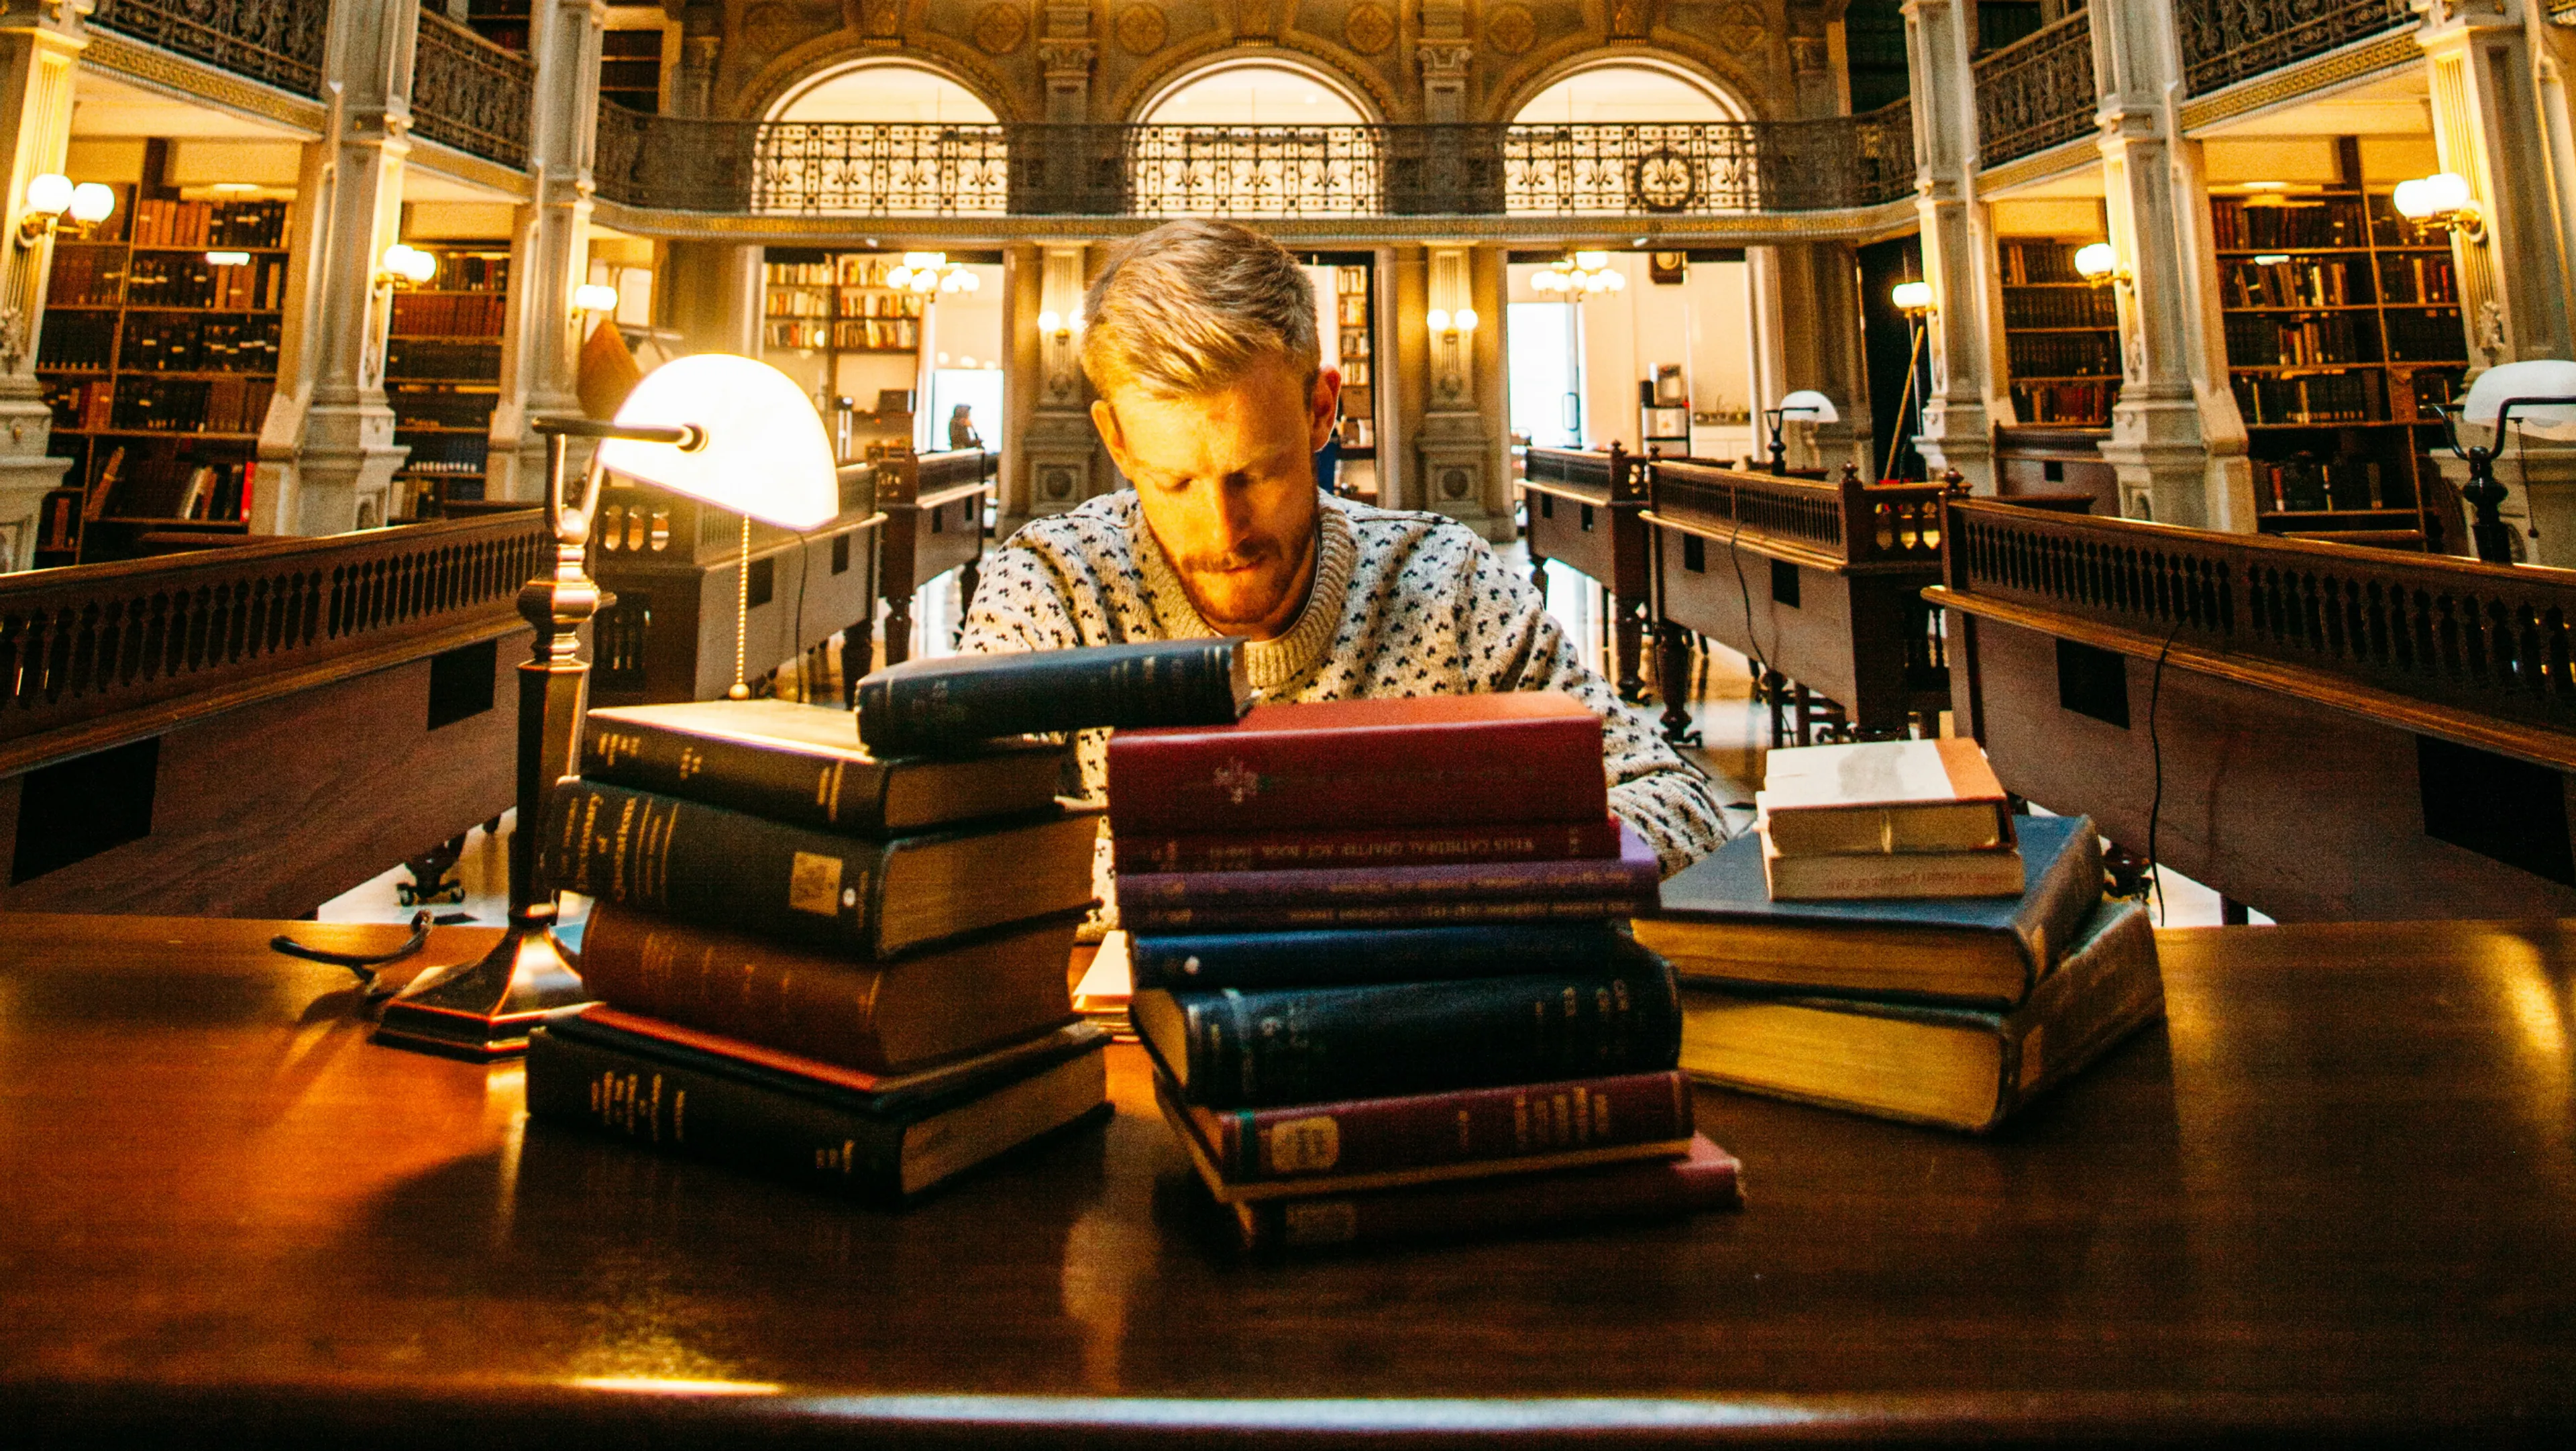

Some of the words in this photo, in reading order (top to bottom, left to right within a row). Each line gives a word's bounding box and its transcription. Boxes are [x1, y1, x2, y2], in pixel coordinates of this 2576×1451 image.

[576, 792, 604, 892] Dictionary
[595, 835, 609, 855] of
[612, 797, 638, 902] Quotations
